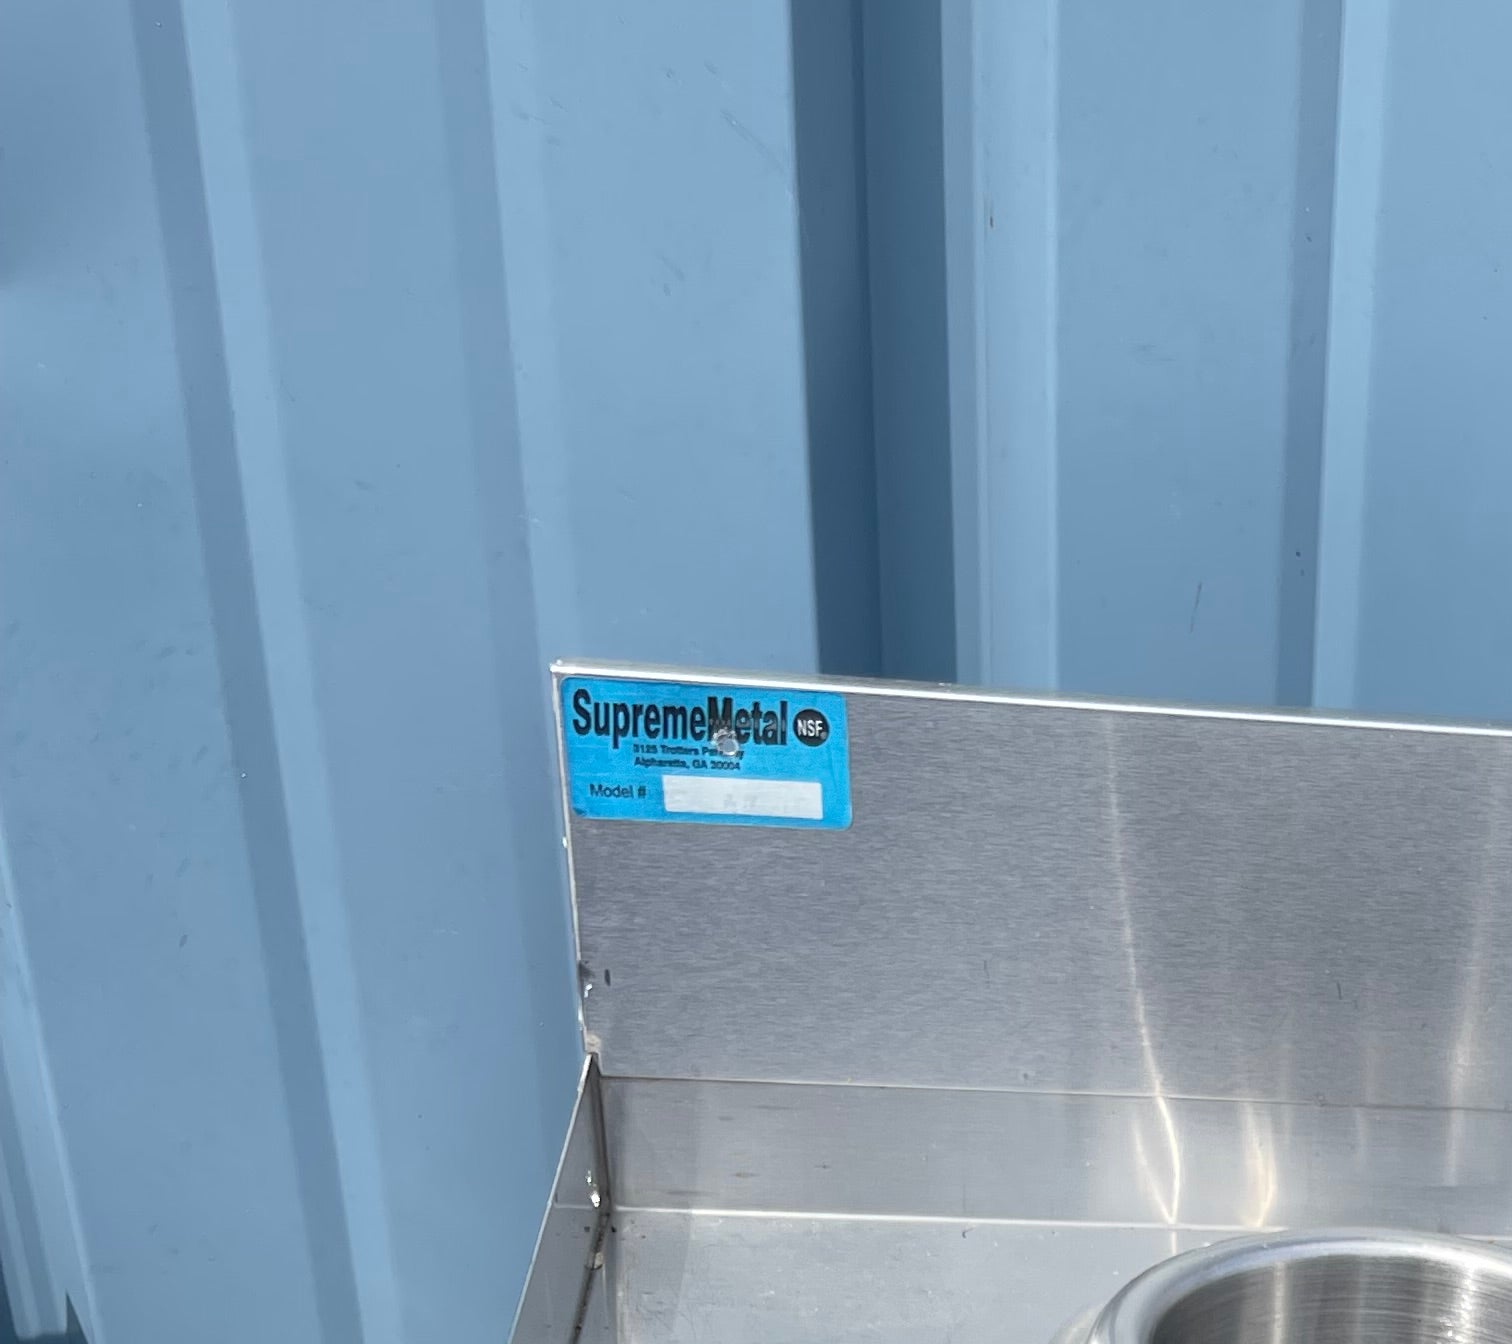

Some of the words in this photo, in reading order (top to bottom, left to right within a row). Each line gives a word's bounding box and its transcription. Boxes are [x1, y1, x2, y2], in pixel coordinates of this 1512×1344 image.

[796, 718, 823, 737] NSF
[692, 759, 708, 769] GA
[590, 783, 634, 798] Model
[637, 785, 647, 799] #
